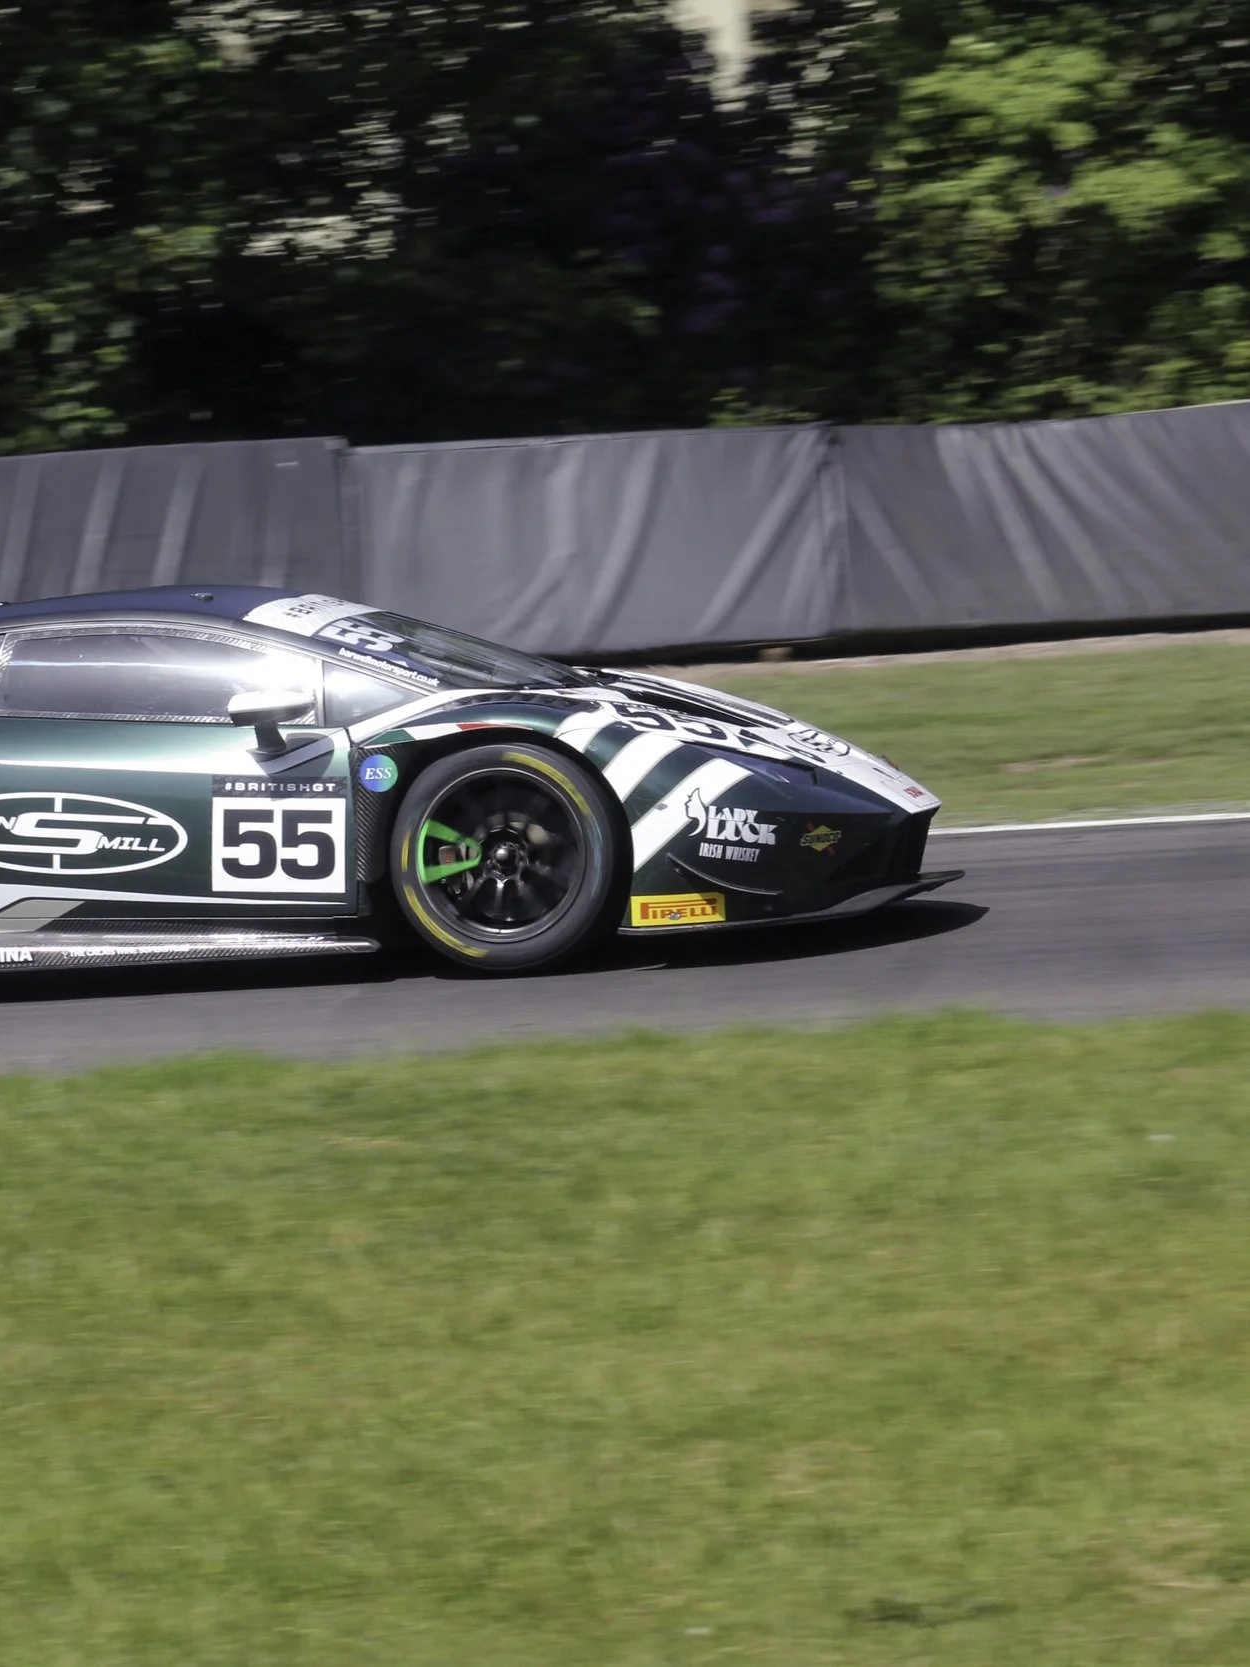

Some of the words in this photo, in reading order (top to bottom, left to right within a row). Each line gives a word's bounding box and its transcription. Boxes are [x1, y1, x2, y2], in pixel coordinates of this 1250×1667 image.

[339, 647, 440, 686] barwellmotorsport.co.uk
[365, 766, 392, 780] ESS
[225, 782, 336, 792] #BRITISHGT
[707, 805, 759, 823] LADY
[706, 818, 778, 845] LUCK
[97, 835, 166, 852] MILL
[221, 808, 336, 881] 55
[699, 842, 724, 859] IRISH
[725, 844, 761, 863] WHISKEY
[640, 897, 718, 920] PIRELLI
